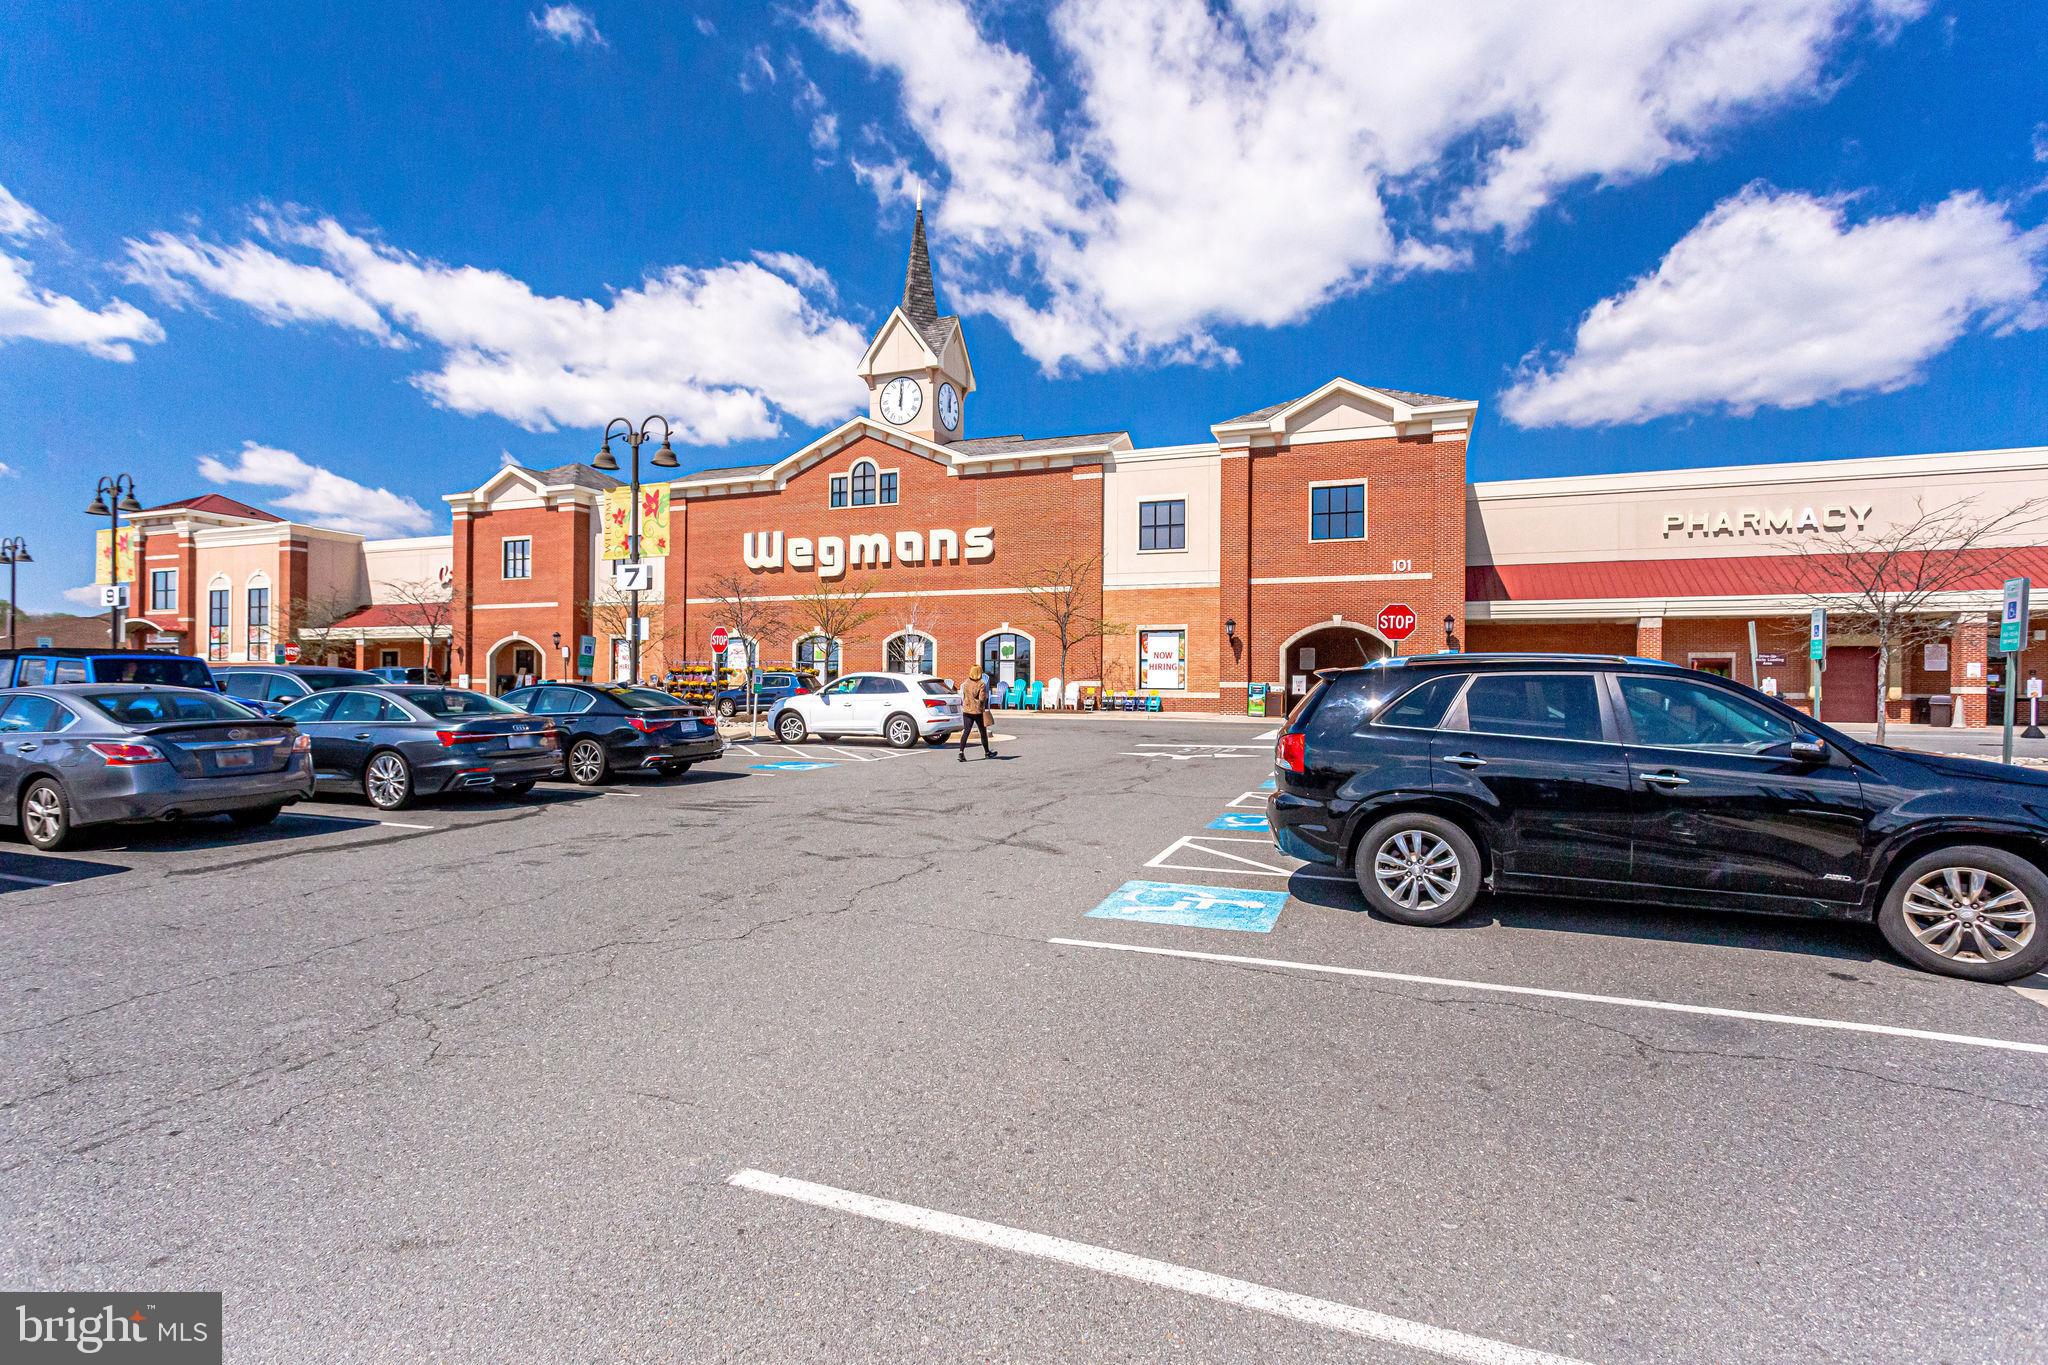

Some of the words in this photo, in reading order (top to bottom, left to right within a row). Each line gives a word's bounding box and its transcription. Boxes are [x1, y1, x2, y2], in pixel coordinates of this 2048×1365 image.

[1663, 503, 1873, 538] PHARMACY
[743, 526, 996, 580] Wegmans
[1392, 559, 1412, 572] 101
[624, 567, 640, 588] 7
[1379, 614, 1414, 629] STOP
[712, 635, 728, 646] STOP
[1153, 651, 1173, 659] NOW
[1148, 663, 1178, 671] HIRING
